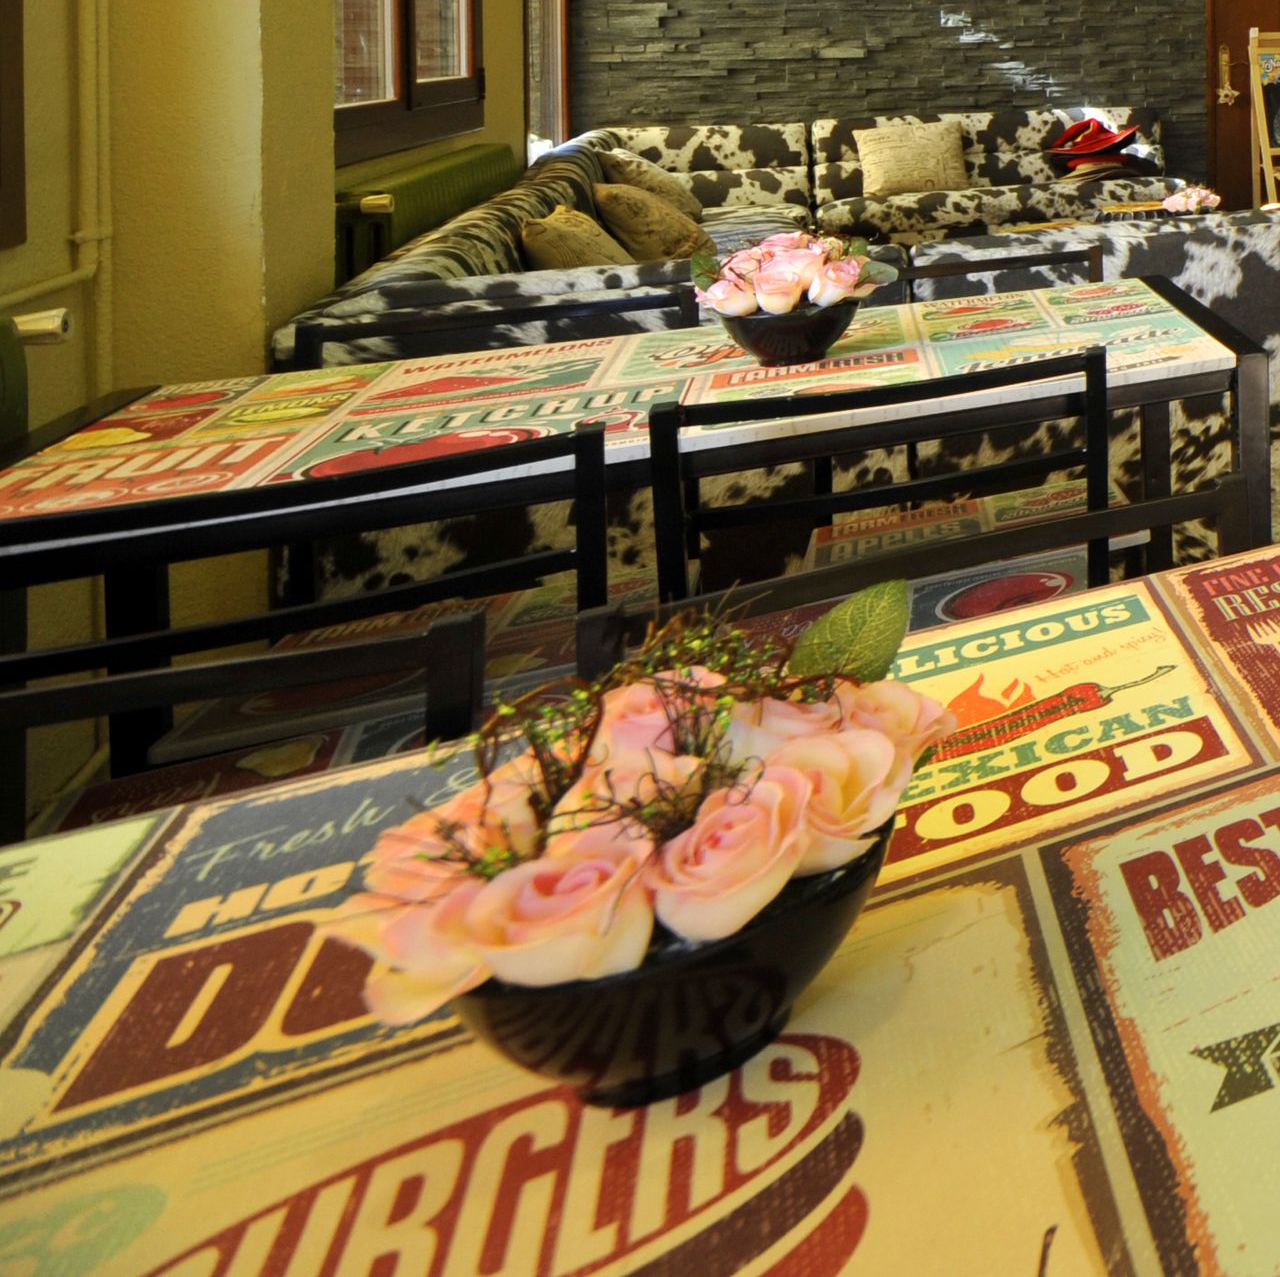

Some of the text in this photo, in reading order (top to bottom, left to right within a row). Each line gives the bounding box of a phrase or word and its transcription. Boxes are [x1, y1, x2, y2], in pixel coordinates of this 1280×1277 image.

[402, 337, 616, 375] WATERMELONS
[340, 385, 674, 442] KETCHUP
[0, 433, 290, 495] FRUIT
[1202, 566, 1271, 599] FINE
[884, 602, 1134, 680] LICIOUS
[1033, 660, 1080, 685] Hot
[1081, 646, 1118, 669] and
[901, 696, 1196, 800] EXICAN
[184, 796, 392, 880] Fresh
[163, 852, 376, 939] HO
[148, 1037, 860, 1277] URGERS
